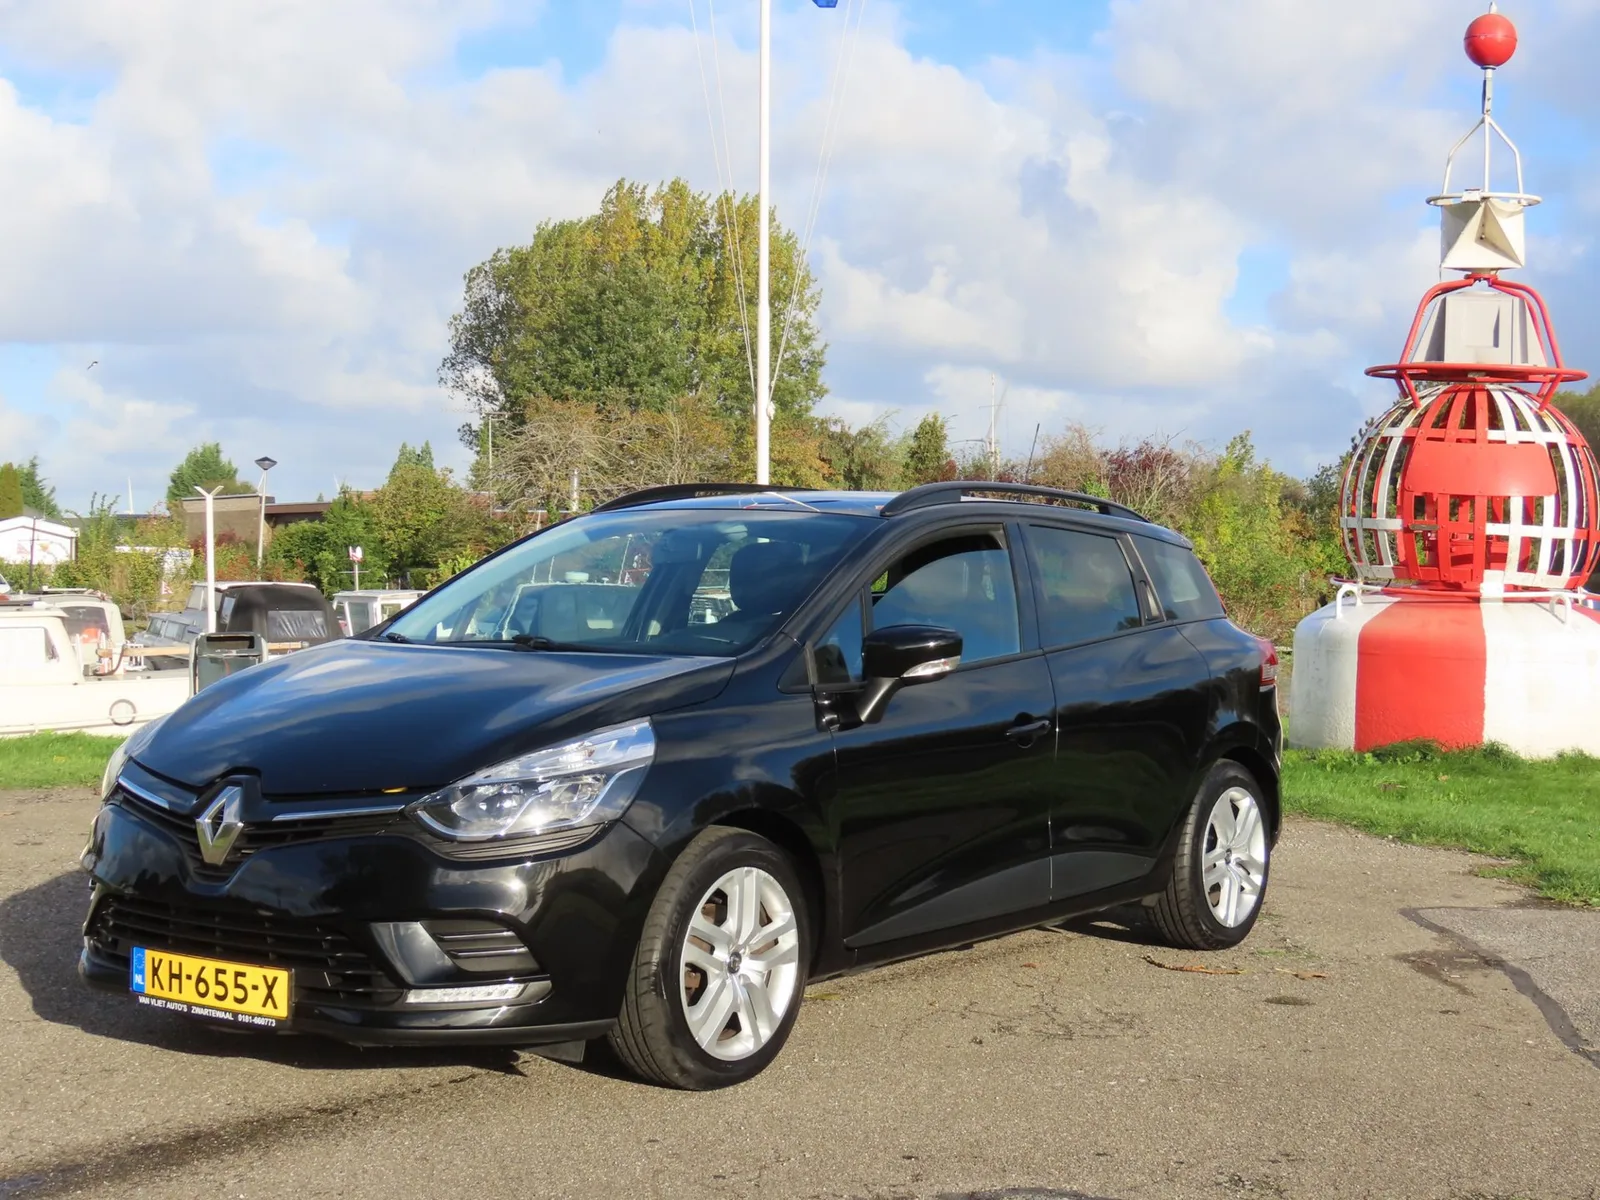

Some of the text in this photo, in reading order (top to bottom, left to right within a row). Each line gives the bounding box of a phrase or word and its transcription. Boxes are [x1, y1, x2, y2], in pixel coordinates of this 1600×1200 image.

[135, 974, 144, 985] NL
[151, 957, 279, 1010] KH-655-X
[139, 995, 150, 1005] VAN
[150, 998, 166, 1008] VLIET
[166, 1001, 188, 1013] AUTO'S
[191, 1007, 234, 1021] ZWARTEWAAL
